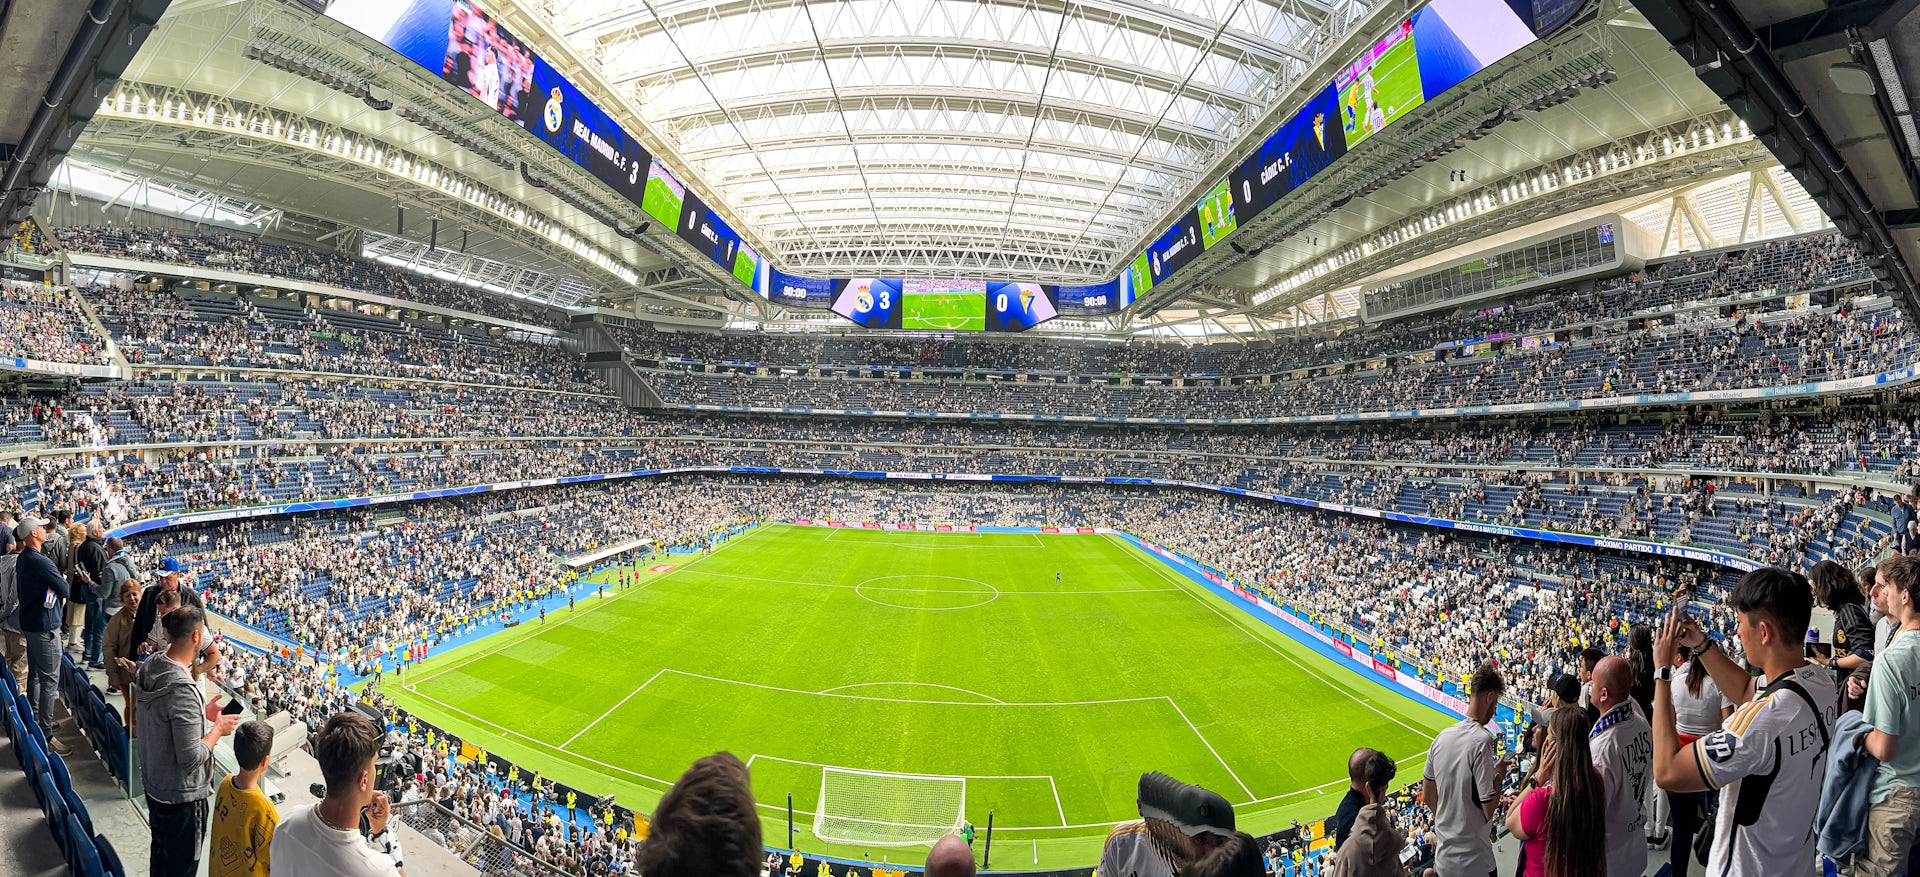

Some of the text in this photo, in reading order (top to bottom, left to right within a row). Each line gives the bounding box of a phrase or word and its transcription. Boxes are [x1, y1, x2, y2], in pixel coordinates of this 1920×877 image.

[573, 119, 639, 184] REAL MADRID C. F. 3
[1243, 152, 1292, 203] 0 CÁDIZ C. F.
[688, 210, 696, 230] 0
[1189, 226, 1196, 245] 3
[783, 286, 807, 298] 90:00
[879, 291, 890, 310] 3
[1083, 295, 1107, 307] 90:00
[997, 293, 1008, 312] 0
[1787, 385, 1807, 393] Madrid
[1594, 539, 1623, 550] PRÓXIMO
[1624, 542, 1653, 553] PARTIDO
[1665, 547, 1684, 557] REAL
[1684, 549, 1711, 562] MADRID
[1731, 559, 1753, 573] BAYERN
